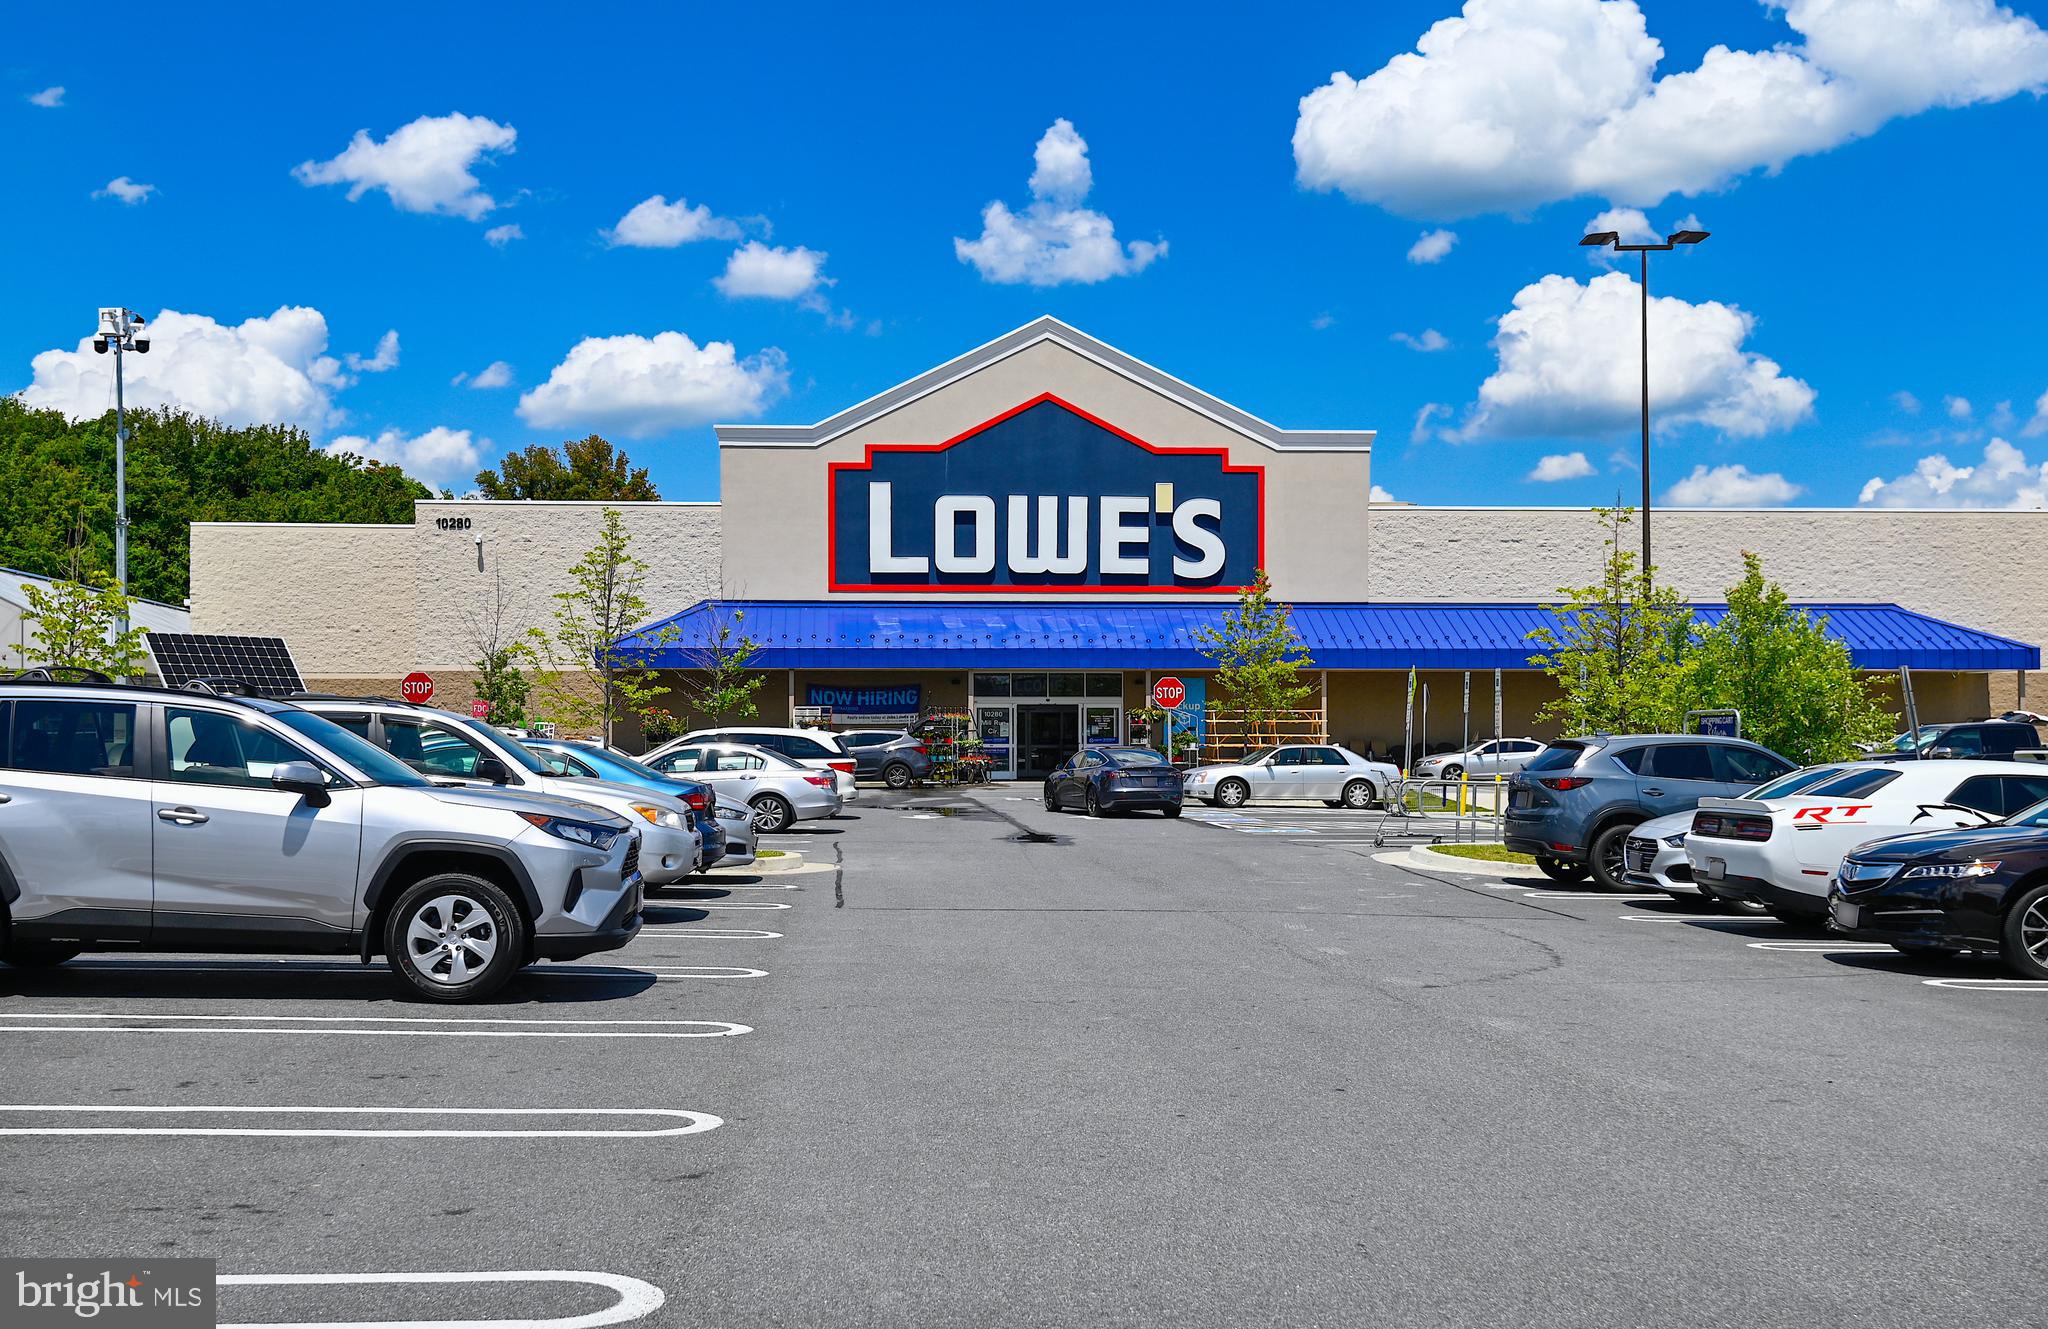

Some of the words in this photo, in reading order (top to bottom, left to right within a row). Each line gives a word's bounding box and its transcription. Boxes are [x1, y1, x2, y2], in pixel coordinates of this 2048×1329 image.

[436, 517, 471, 530] 10280
[869, 481, 1226, 579] LOWE'S
[403, 681, 432, 694] STOP
[1156, 686, 1182, 699] STOP
[810, 689, 853, 705] NOW
[857, 689, 918, 706] HIRING
[473, 704, 487, 713] FDC
[1176, 701, 1201, 712] ckup
[1701, 717, 1721, 725] SHOPPING
[1793, 806, 1872, 823] RT
